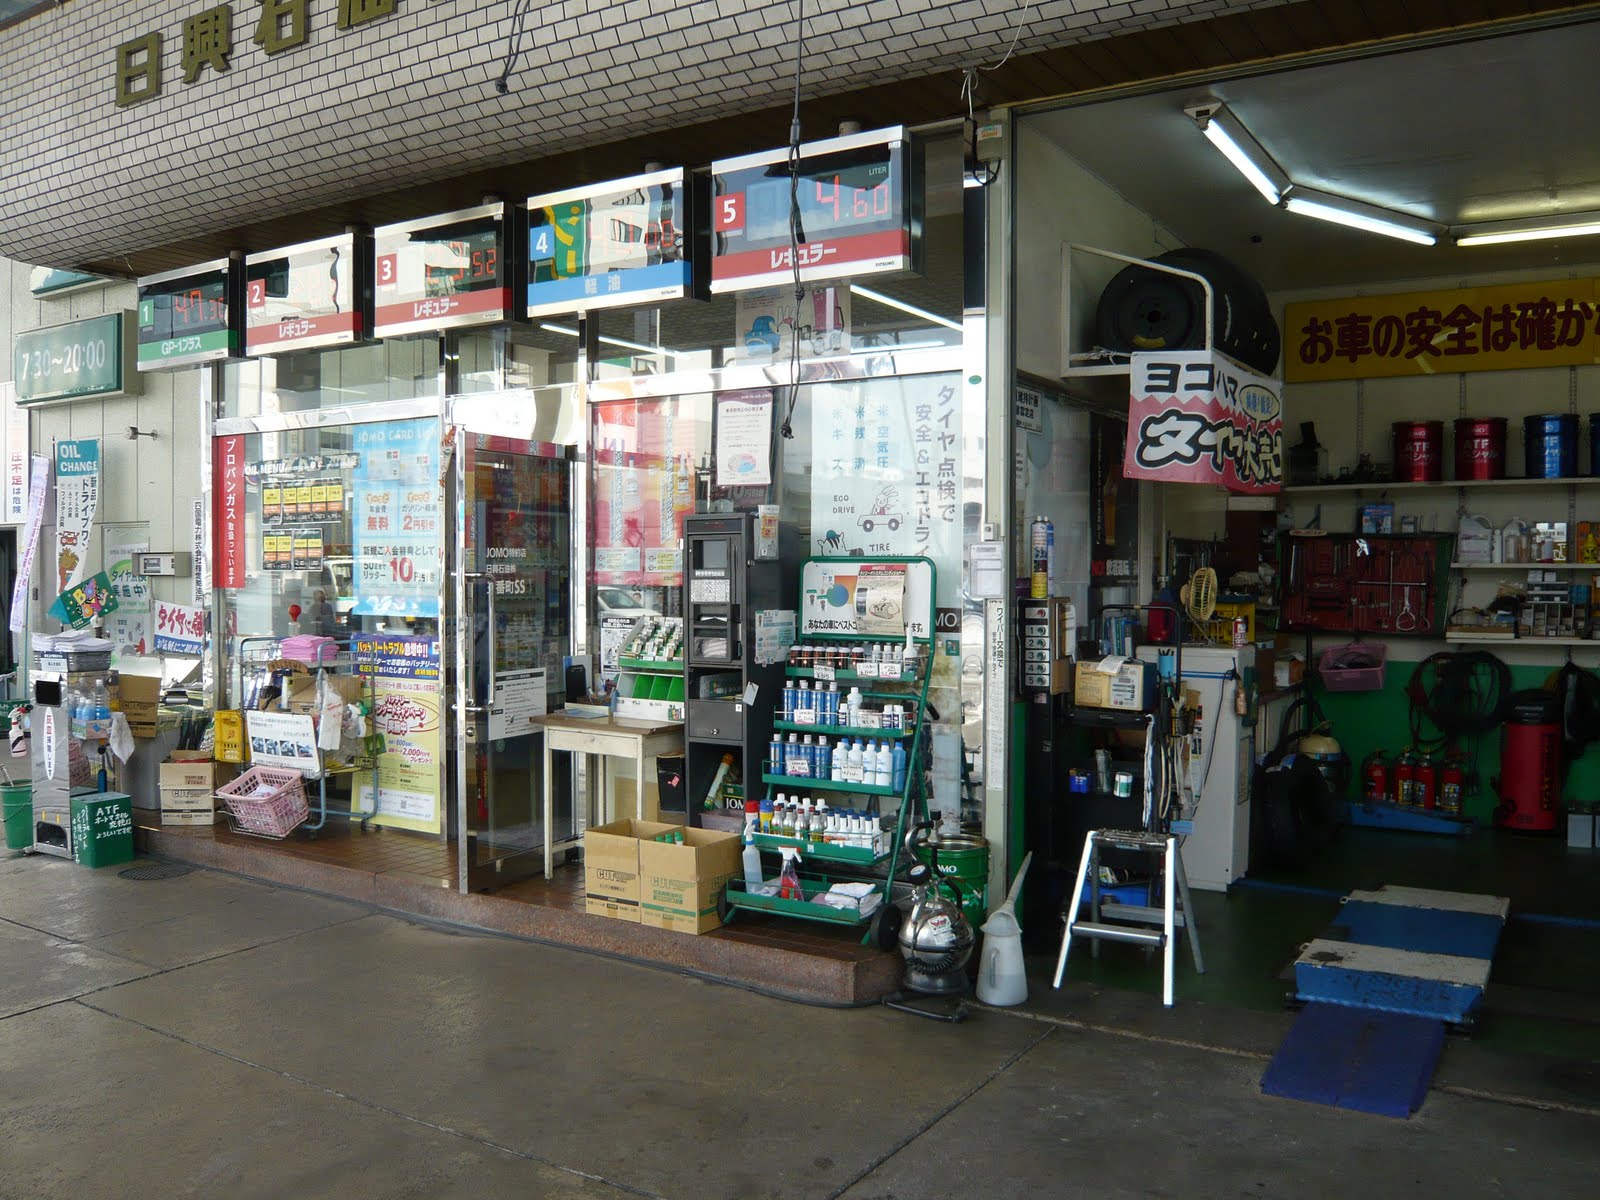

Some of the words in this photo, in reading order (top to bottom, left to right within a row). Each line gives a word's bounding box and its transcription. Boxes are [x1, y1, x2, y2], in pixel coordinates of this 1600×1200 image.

[722, 198, 737, 224] 5
[535, 232, 548, 253] 4
[381, 260, 392, 279] 3
[584, 274, 621, 295] 軽油
[252, 285, 260, 303] 2
[142, 305, 149, 321] 1
[413, 300, 459, 317] レギュラー
[279, 322, 316, 338] レギュラー
[161, 337, 202, 355] GP-1プラス
[1144, 362, 1239, 407] ヨコハマ
[358, 431, 385, 442] JOMO
[389, 429, 414, 440] CARD
[60, 444, 81, 459] OIL
[937, 385, 956, 523] タイヤ点検で
[60, 460, 97, 472] CHANGE
[245, 464, 259, 475] OIL
[260, 462, 285, 474] MENU
[834, 494, 849, 502] ECO
[832, 506, 855, 514] DRIVE
[367, 515, 389, 531] 無料
[869, 543, 890, 551] TIRE
[363, 571, 386, 580] リッター
[486, 579, 526, 595] 番町SS
[1030, 627, 1034, 635] 1
[96, 804, 120, 816] ATF
[597, 868, 615, 880] CUT
[651, 876, 672, 890] CUT
